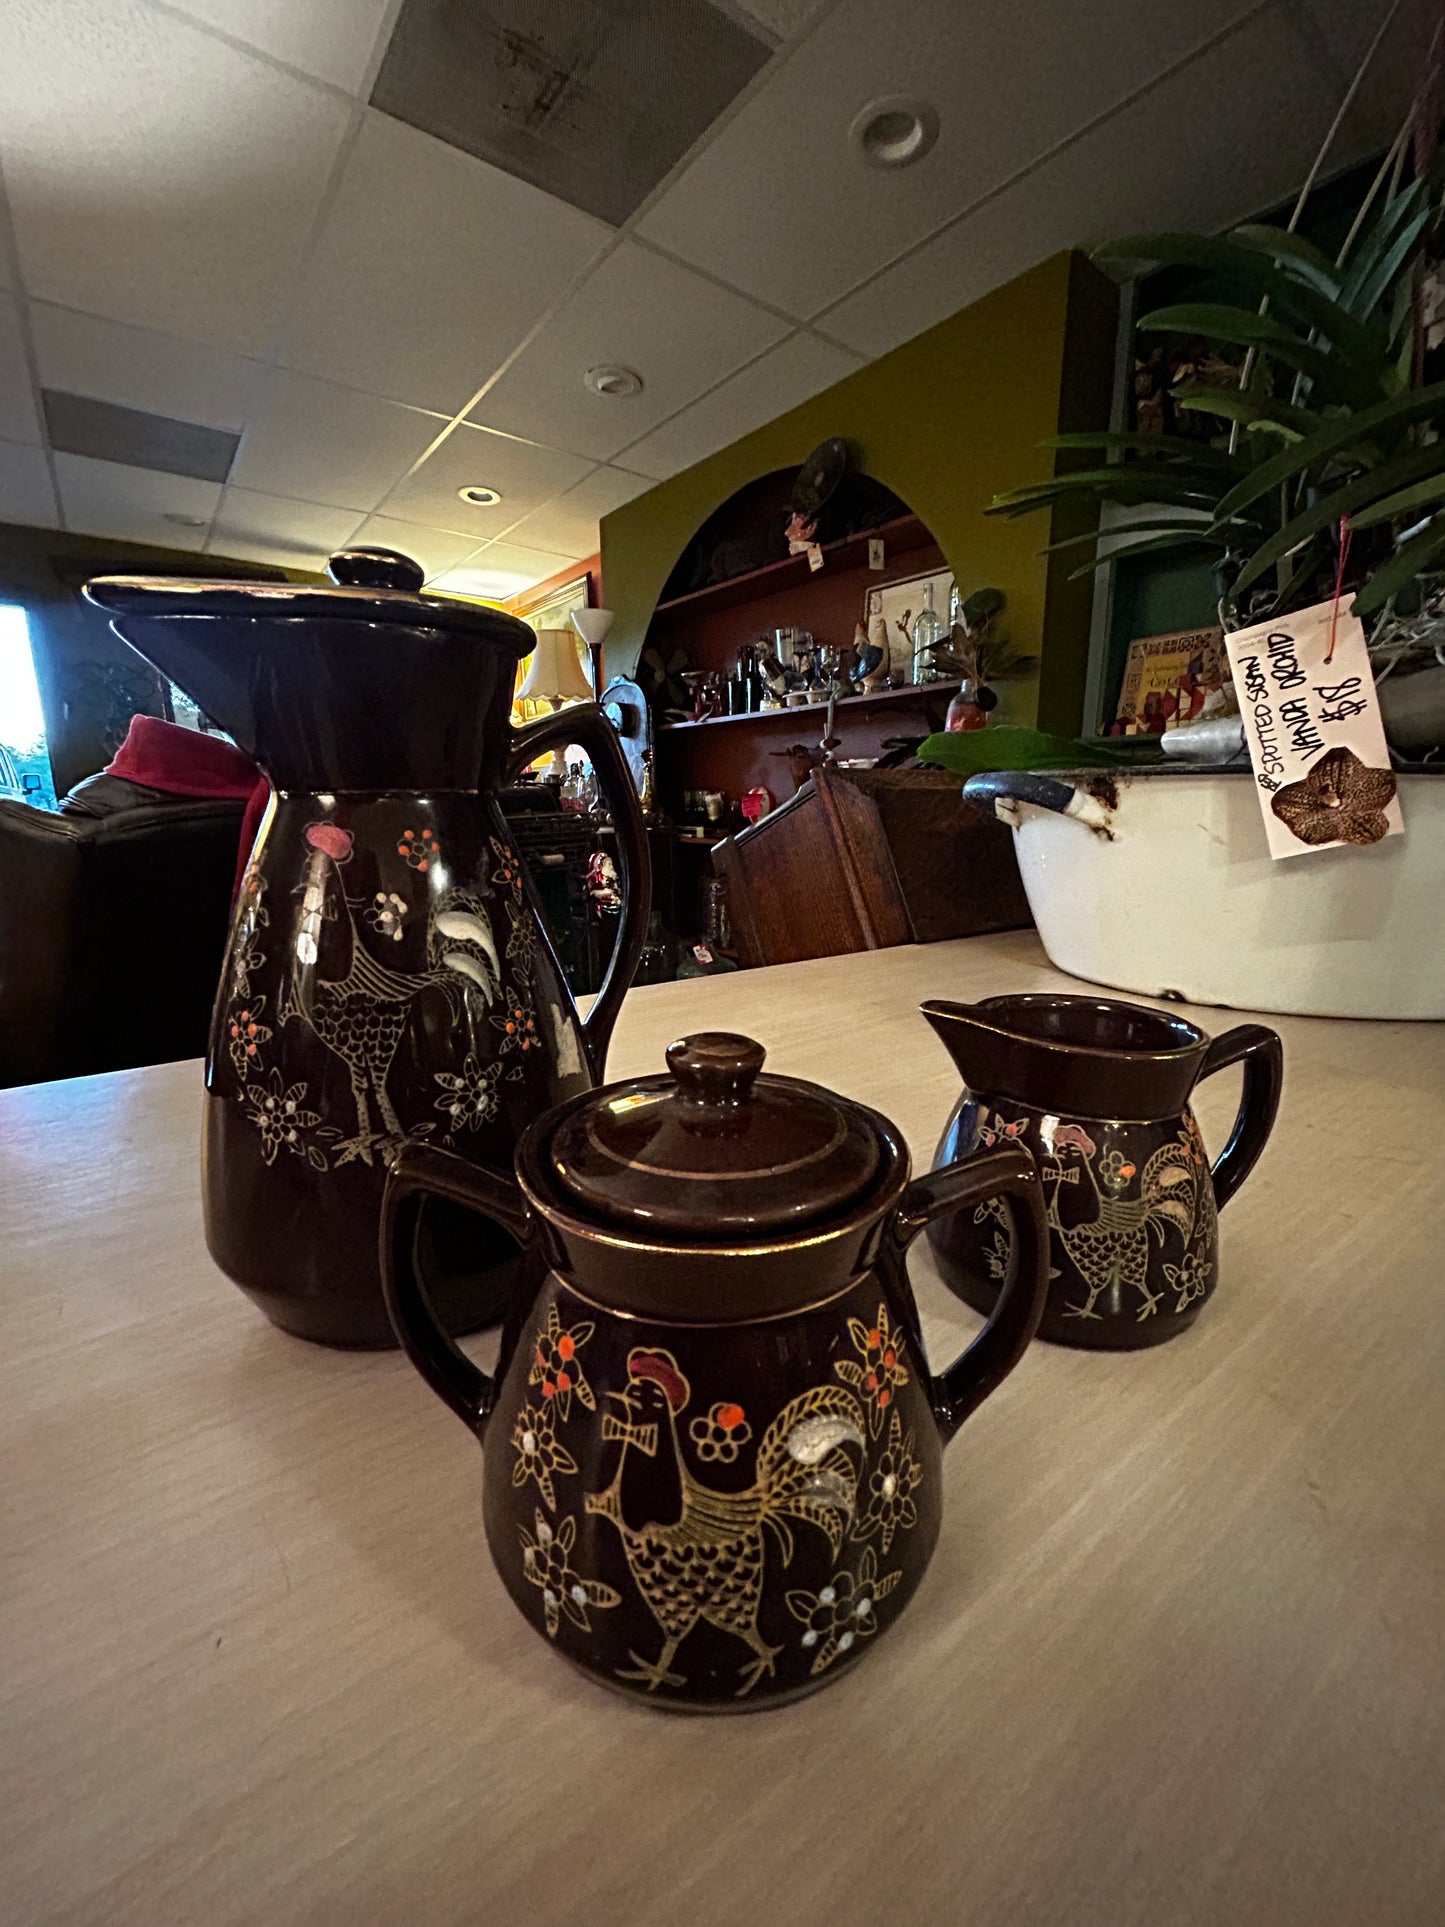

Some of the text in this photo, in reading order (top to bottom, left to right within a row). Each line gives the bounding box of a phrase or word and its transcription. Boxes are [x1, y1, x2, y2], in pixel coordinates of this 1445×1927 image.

[1237, 656, 1269, 702] SUSAN
[1267, 633, 1325, 761] VANDA ORCHID
[1312, 677, 1367, 723] $18
[1254, 703, 1285, 775] SPOTTED
[1257, 773, 1282, 792] RED
